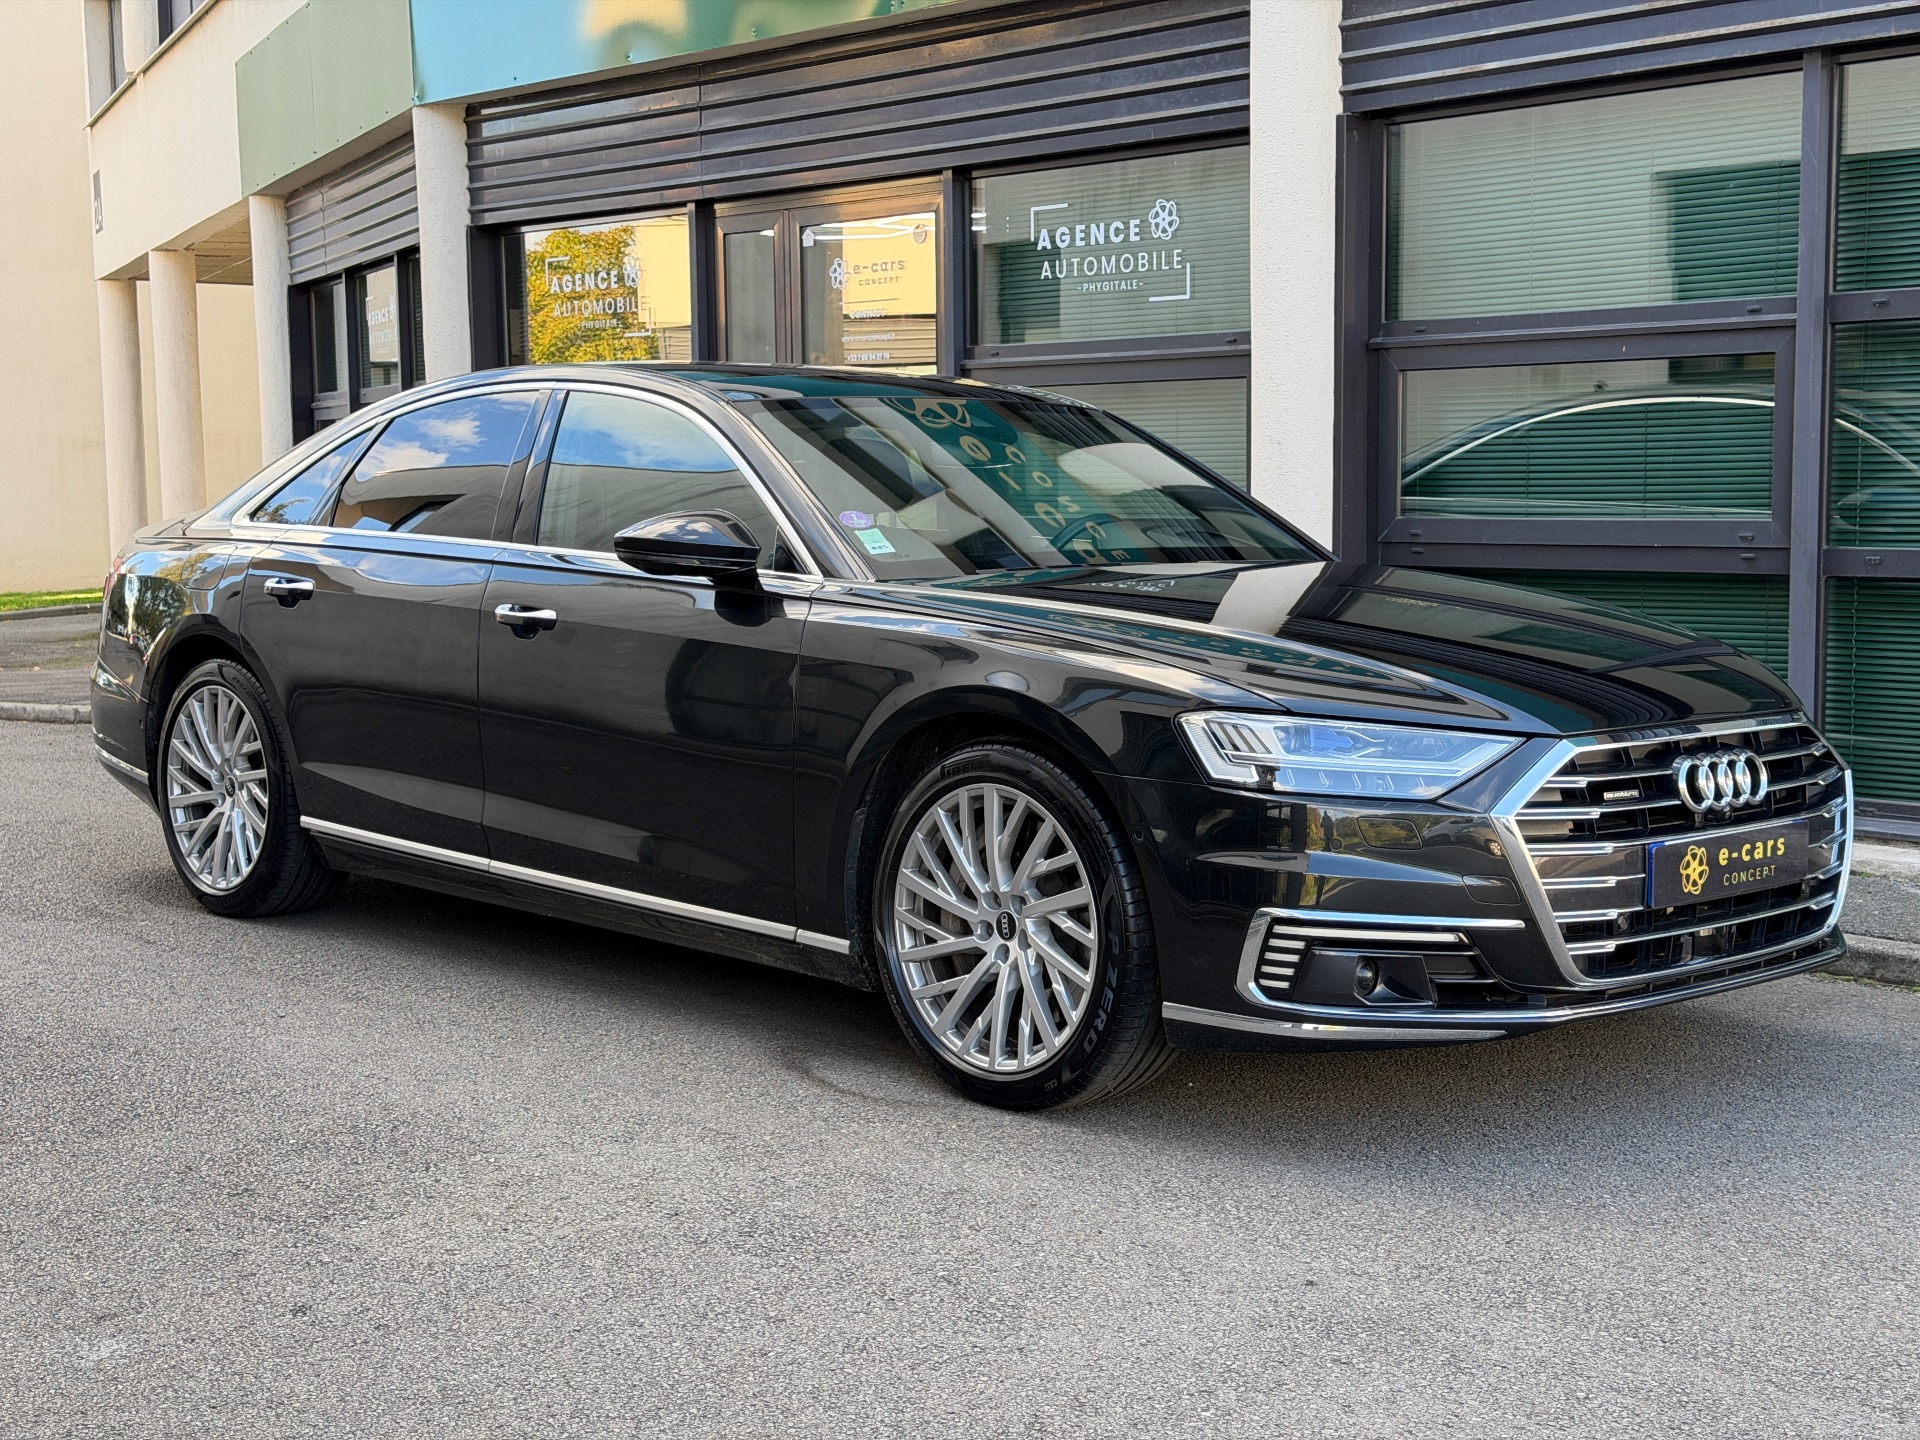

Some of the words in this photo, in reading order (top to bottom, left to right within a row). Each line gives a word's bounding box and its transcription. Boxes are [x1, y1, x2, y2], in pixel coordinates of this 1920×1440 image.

[1037, 219, 1141, 250] AGENCE
[853, 260, 905, 275] e-cars
[1041, 249, 1182, 279] AUTOMOBILE
[551, 270, 618, 294] AGENCE
[858, 276, 901, 286] CONCEPT
[553, 296, 650, 318] AUTOMOBILE
[1605, 790, 1639, 799] quattro
[1718, 837, 1785, 866] e-cars
[1723, 864, 1776, 886] CONCEPT
[1108, 930, 1120, 955] P
[1083, 961, 1118, 1054] ZERO
